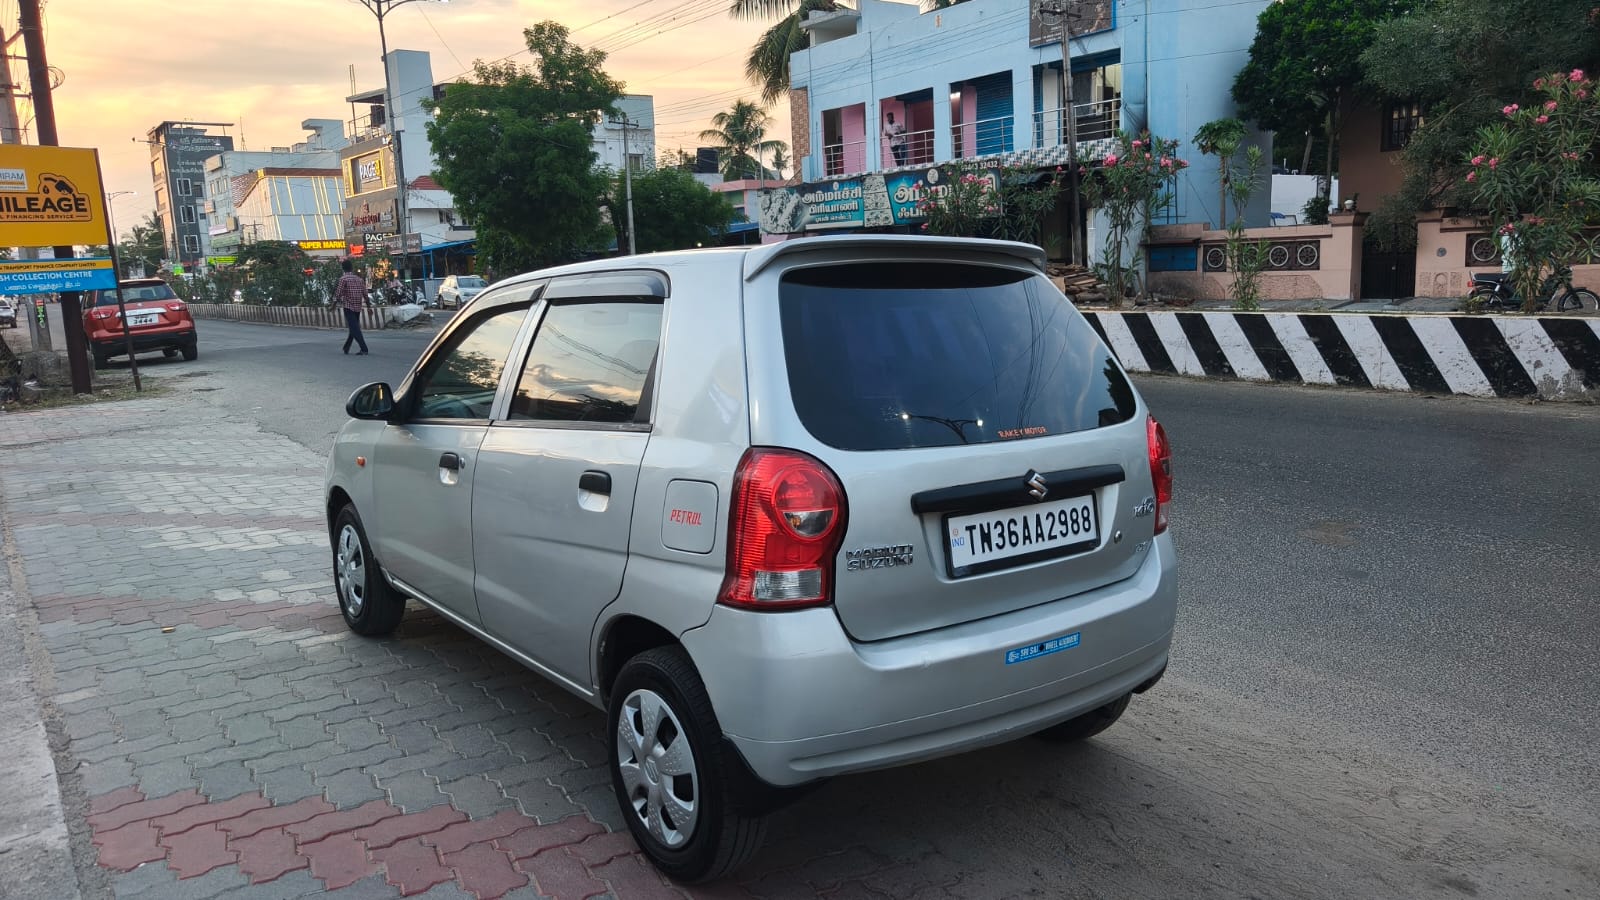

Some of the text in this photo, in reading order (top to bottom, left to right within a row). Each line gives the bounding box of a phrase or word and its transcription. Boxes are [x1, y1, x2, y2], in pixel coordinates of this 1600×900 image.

[300, 241, 321, 249] SUPER
[12, 272, 62, 281] COLLECTION
[63, 270, 93, 279] CENTRE
[670, 508, 702, 526] PETROL
[951, 505, 1092, 556] IND TN36AA2988
[846, 543, 914, 559] MARUTI
[847, 554, 914, 571] SUZUKI
